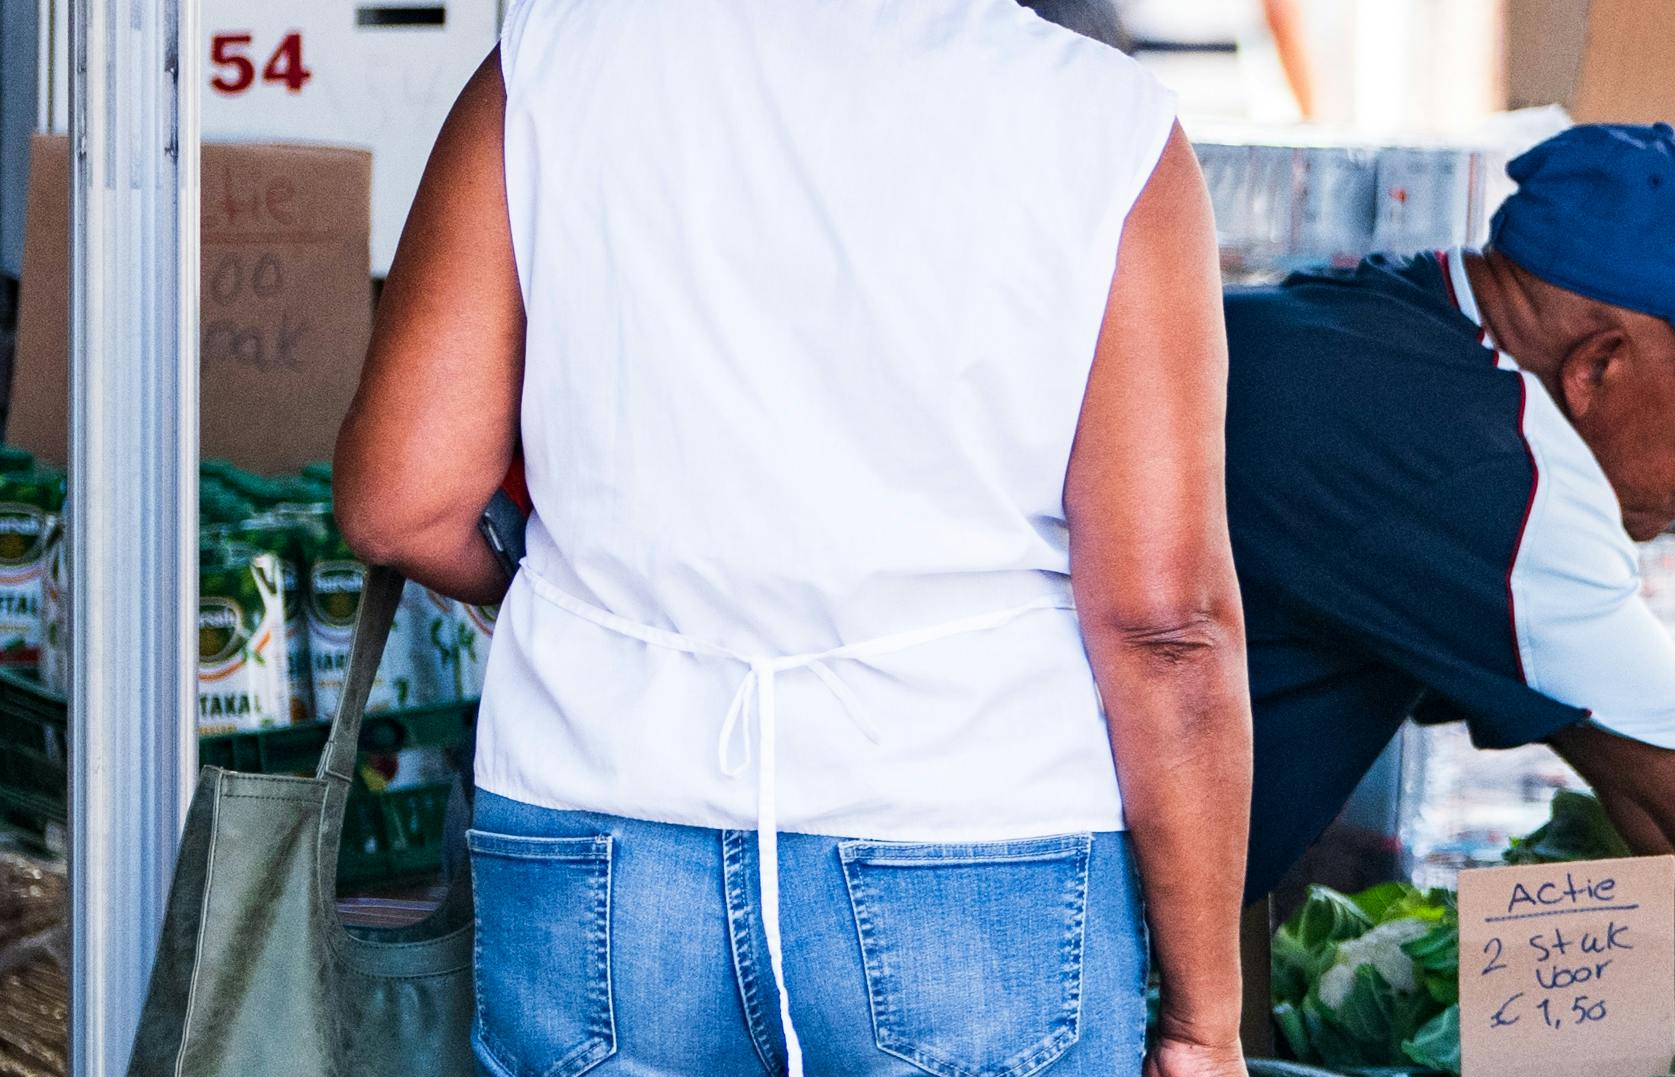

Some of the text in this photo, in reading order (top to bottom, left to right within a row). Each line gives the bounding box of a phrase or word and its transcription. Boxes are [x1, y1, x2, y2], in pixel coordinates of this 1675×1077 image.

[208, 32, 311, 95] 54
[1480, 937, 1508, 976] 2
[1535, 995, 1608, 1030] 1,50
